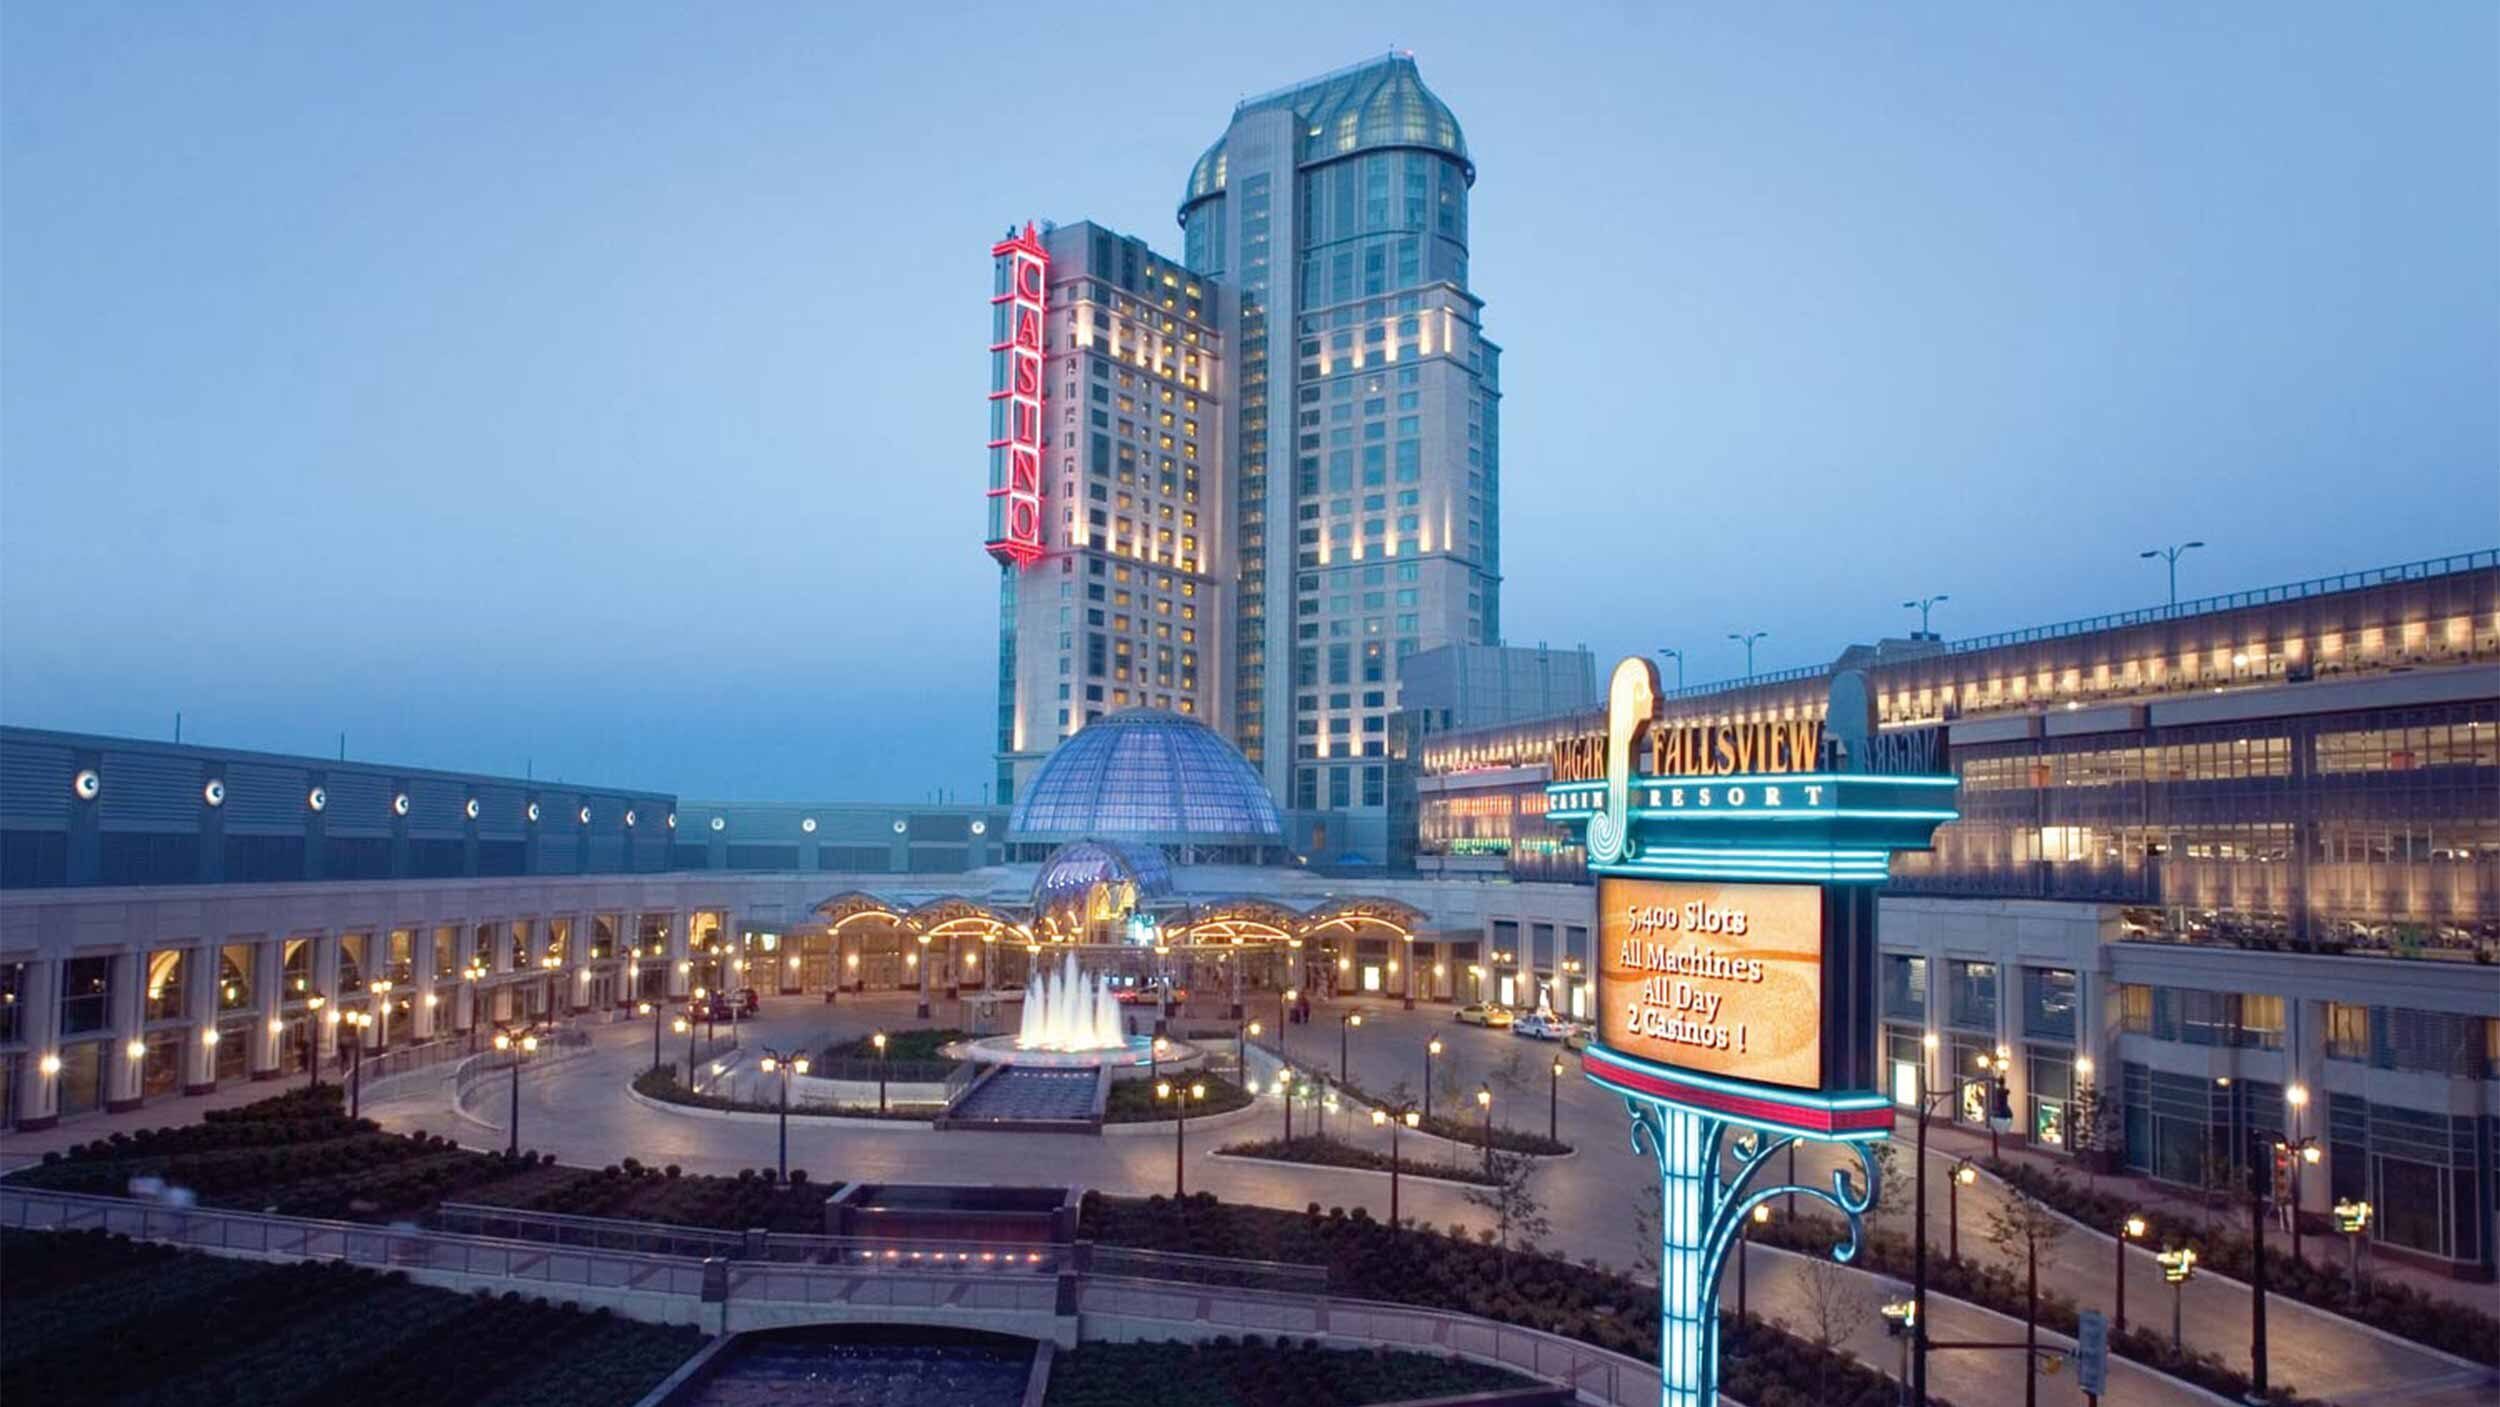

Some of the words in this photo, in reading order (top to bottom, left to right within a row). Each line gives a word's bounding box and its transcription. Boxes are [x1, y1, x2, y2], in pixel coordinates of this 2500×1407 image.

[1012, 258, 1041, 540] CASINO
[1651, 719, 1818, 776] FALLSVIEW
[1550, 791, 1603, 810] CASIN
[1649, 785, 1822, 807] RESORT
[1628, 905, 1678, 935] 5,400
[1686, 901, 1746, 934] Slots
[1620, 939, 1642, 968] All
[1647, 942, 1763, 982] Machines
[1644, 976, 1670, 1006] All
[1676, 982, 1721, 1022] Day
[1627, 1003, 1640, 1033] 2
[1643, 1007, 1729, 1048] Casinos
[1738, 1023, 1746, 1052] !
